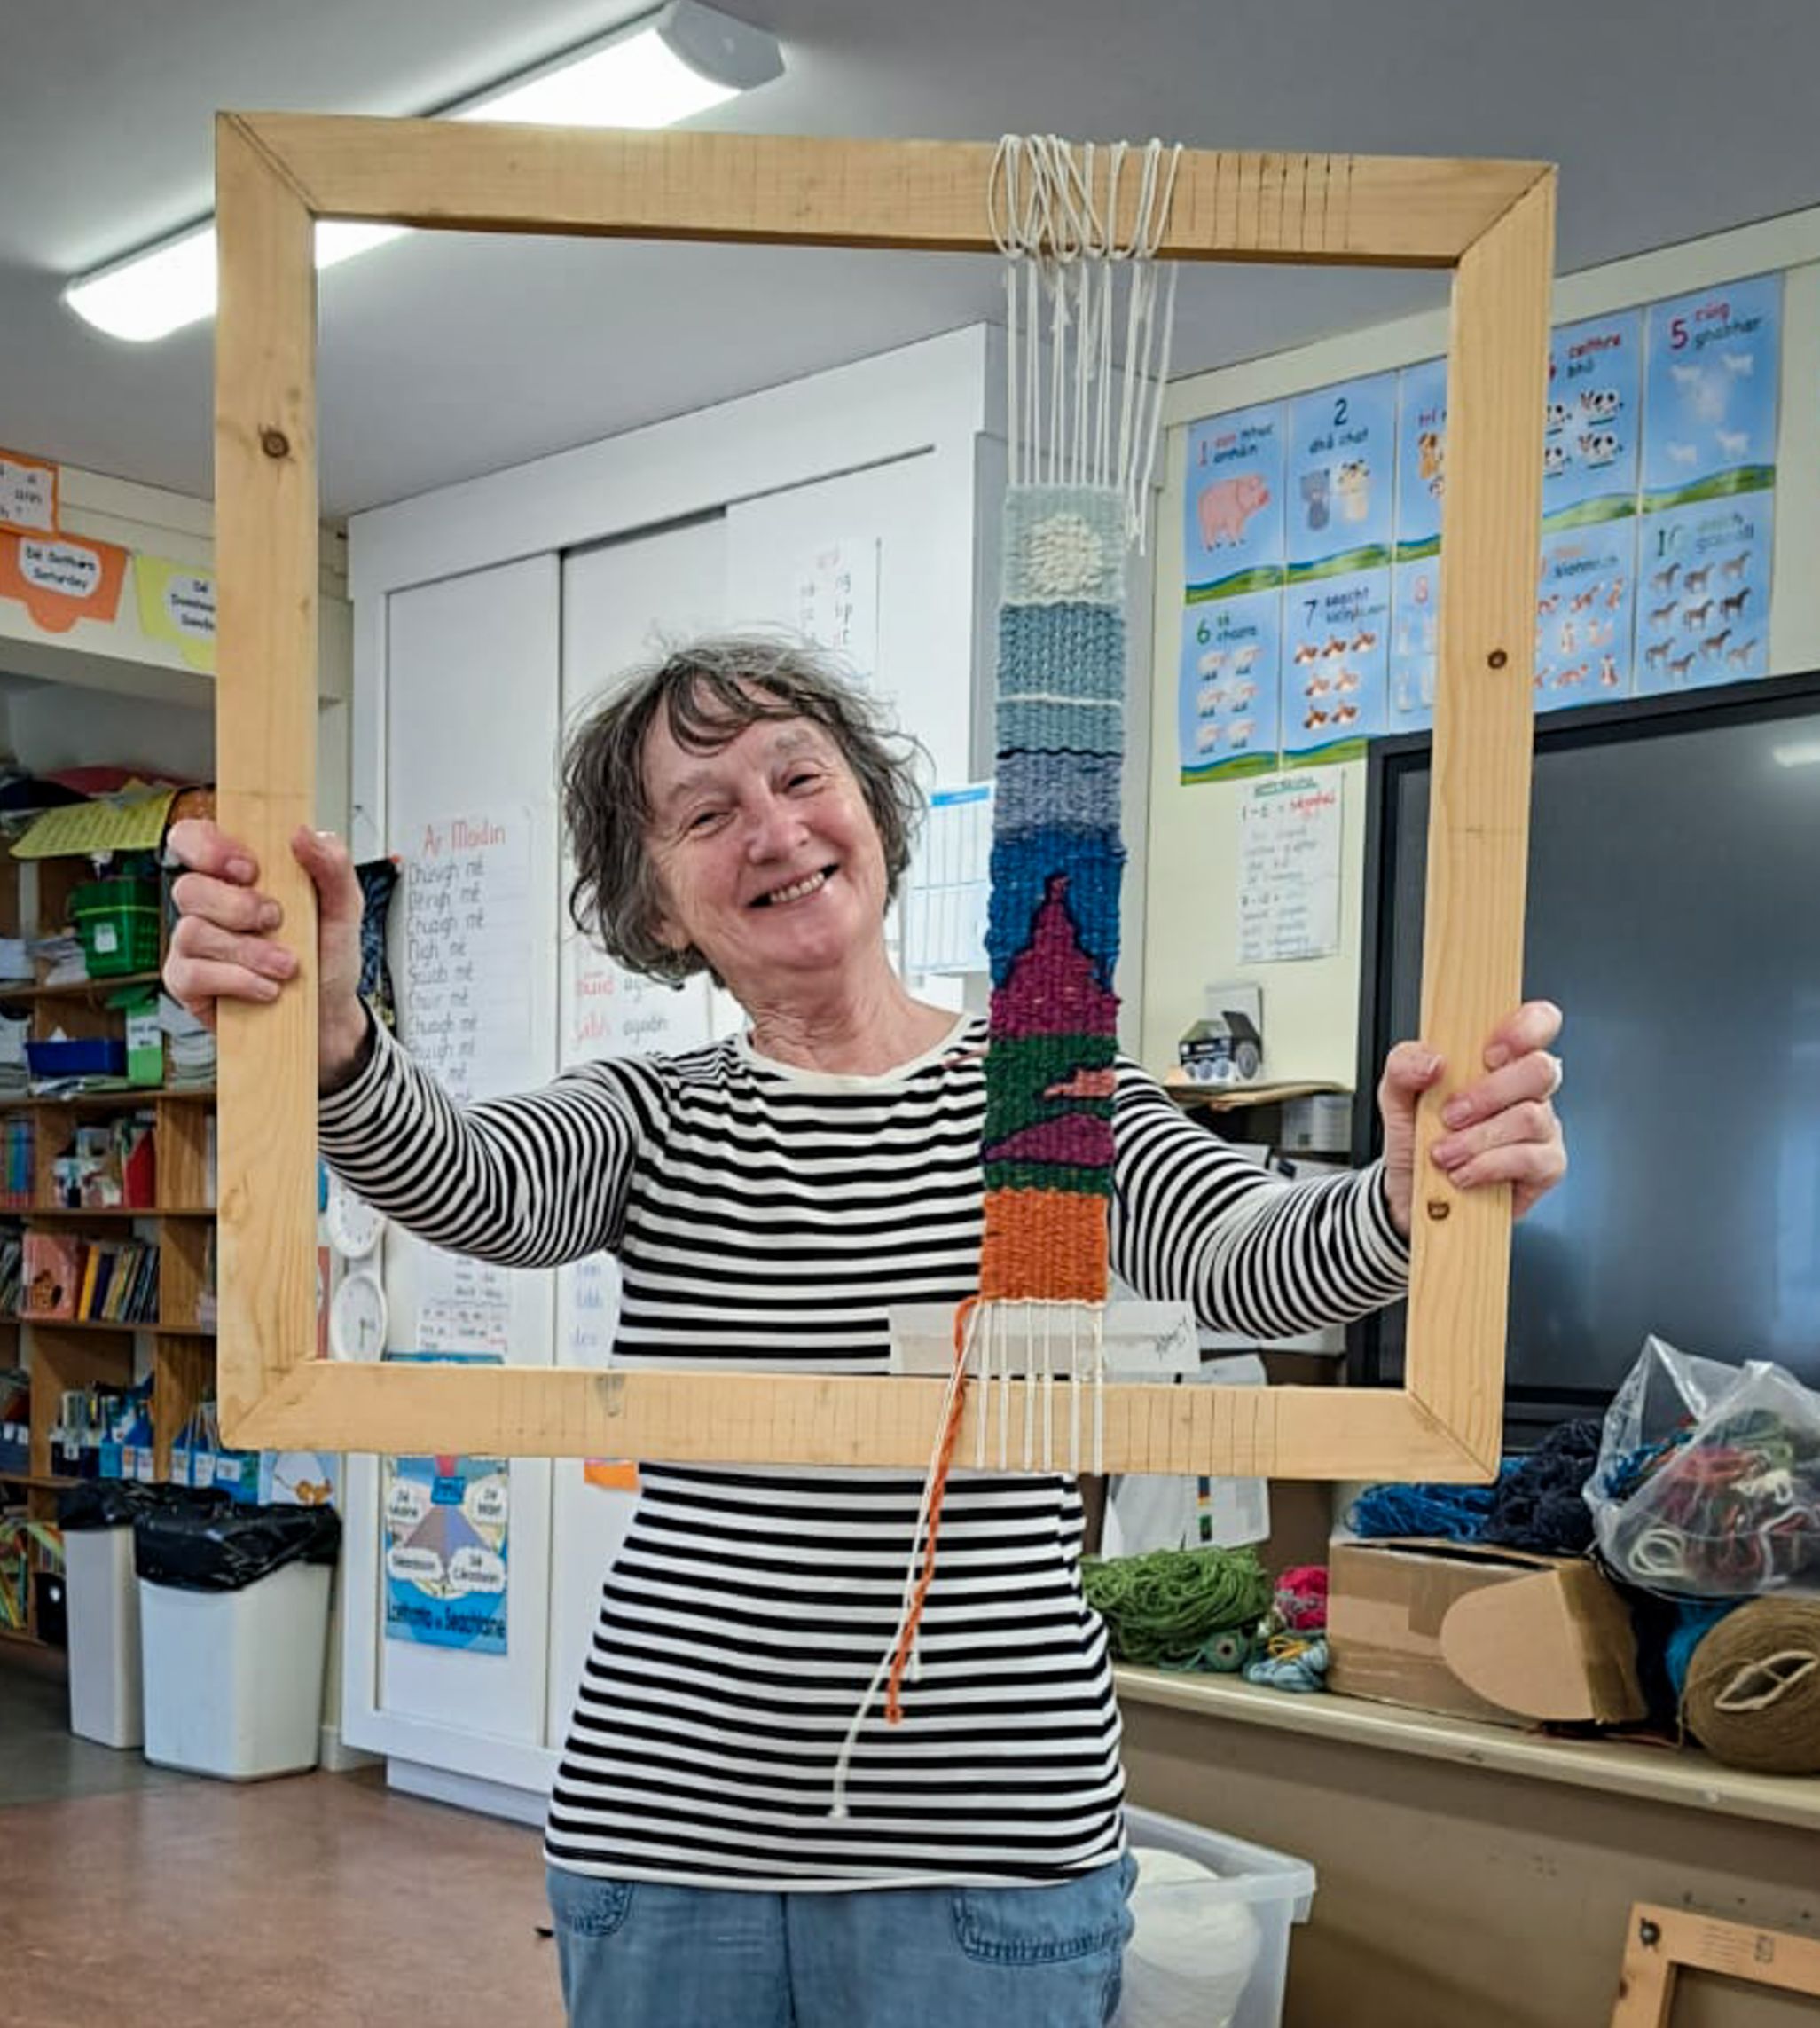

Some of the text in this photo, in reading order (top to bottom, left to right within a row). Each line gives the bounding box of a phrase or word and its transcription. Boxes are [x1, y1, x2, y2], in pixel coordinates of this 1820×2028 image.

[1671, 319, 1689, 350] 5
[1334, 398, 1347, 426] 2
[1304, 598, 1319, 628] 7
[1196, 618, 1211, 645] 6
